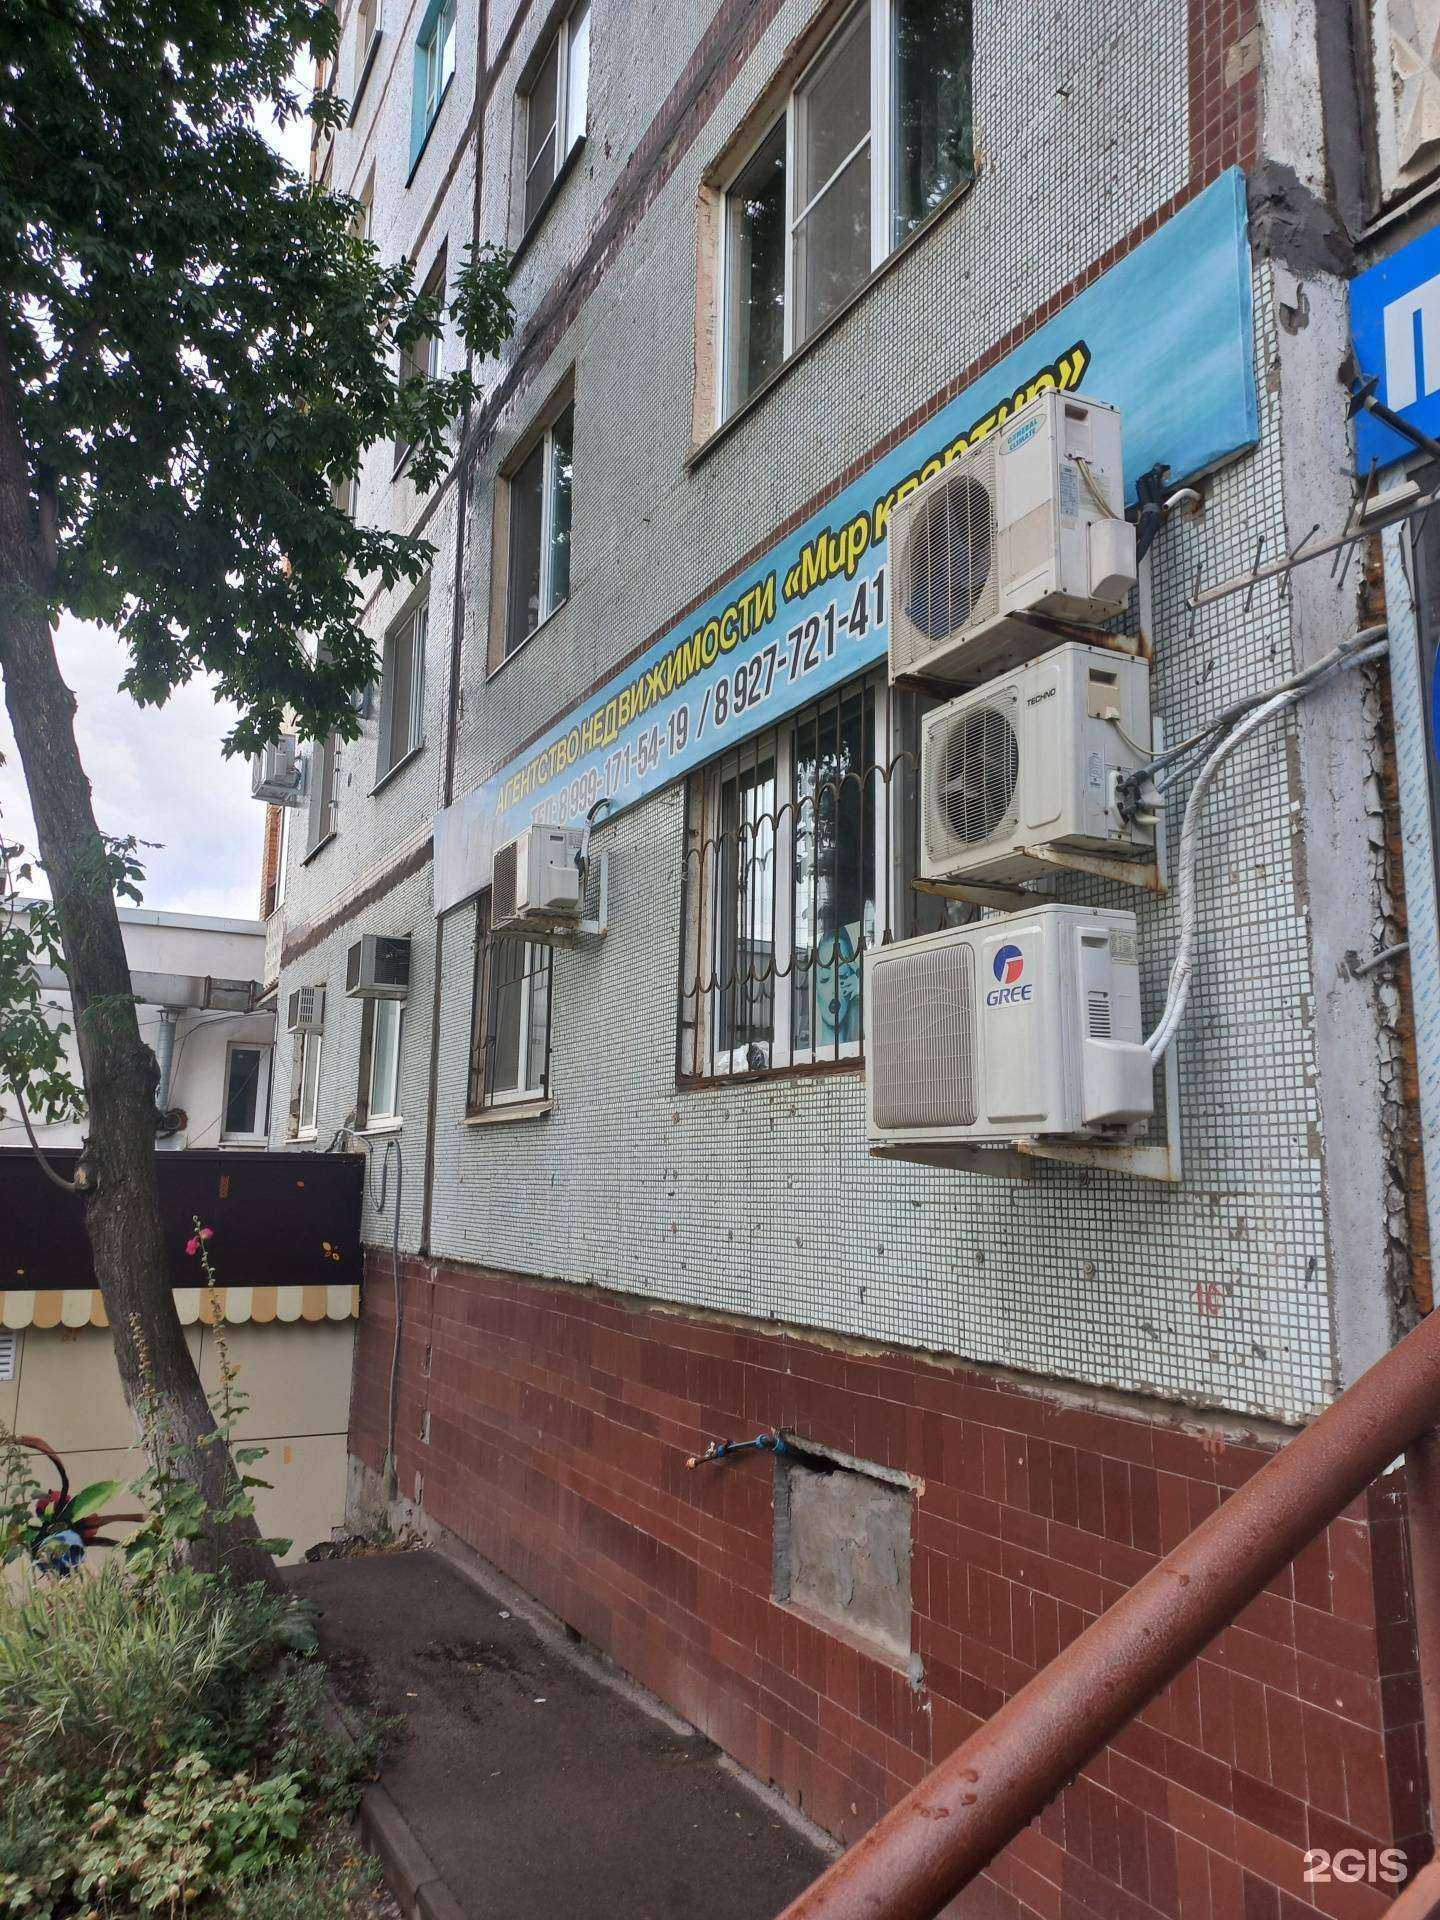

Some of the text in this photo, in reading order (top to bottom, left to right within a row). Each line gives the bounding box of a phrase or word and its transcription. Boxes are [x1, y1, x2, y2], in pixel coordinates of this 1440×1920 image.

[495, 729, 580, 815] АГЕНТСТВО
[580, 574, 776, 756] НЕДВИЖИМОСТИ
[1026, 688, 1056, 707] TECHNO
[986, 984, 1033, 1007] GREE
